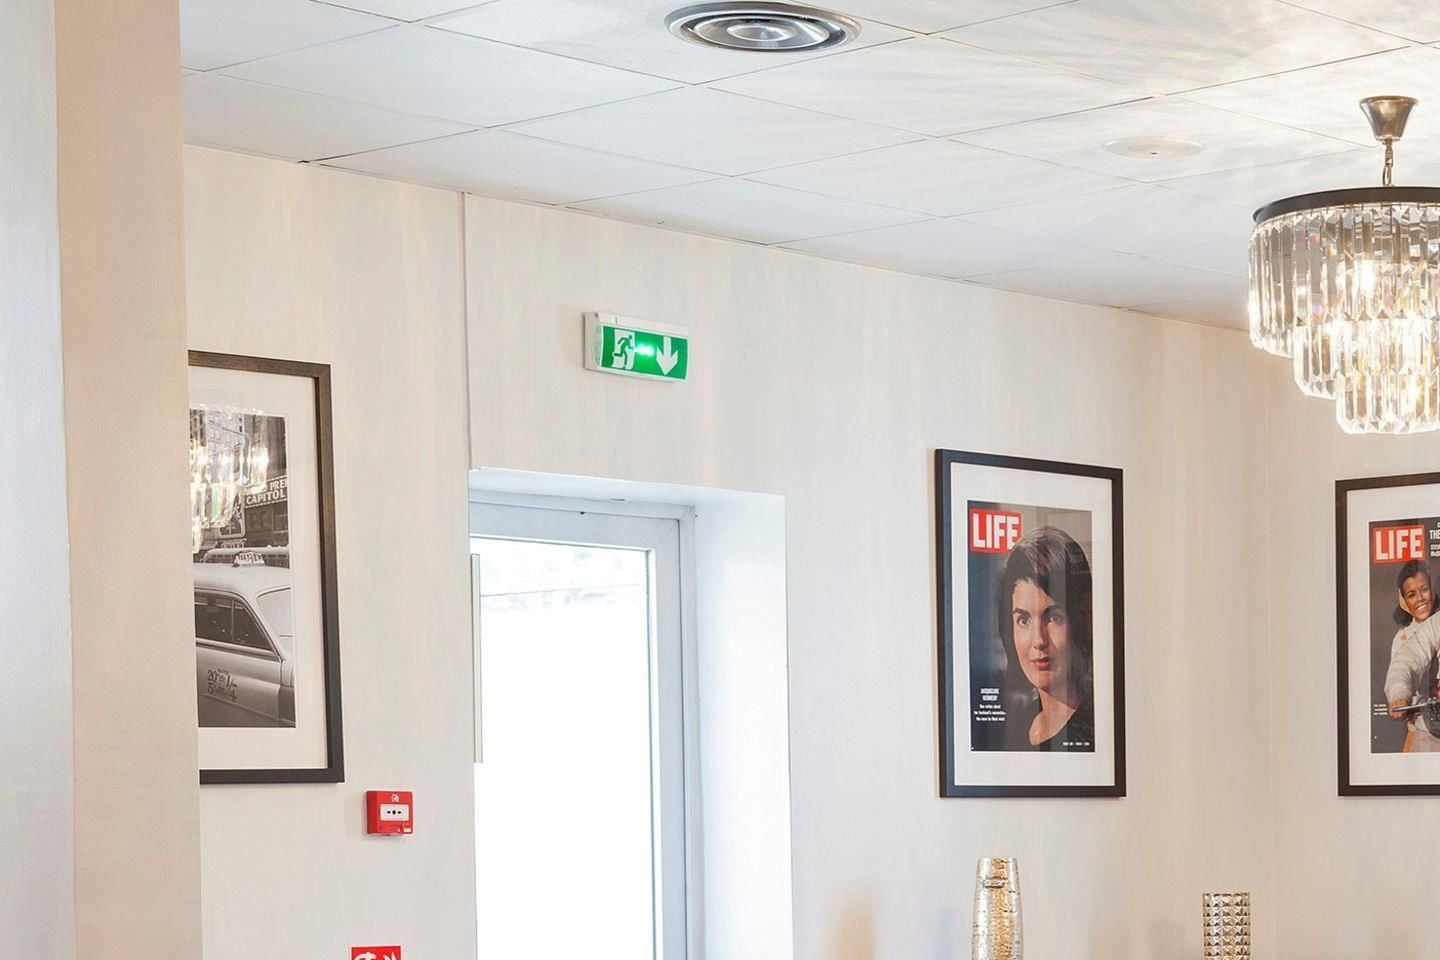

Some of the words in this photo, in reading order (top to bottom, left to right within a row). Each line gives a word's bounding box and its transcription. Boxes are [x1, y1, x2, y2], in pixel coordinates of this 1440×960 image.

[246, 489, 286, 505] CAPITOL
[973, 513, 1019, 550] LIFE
[1375, 528, 1423, 560] LIFE
